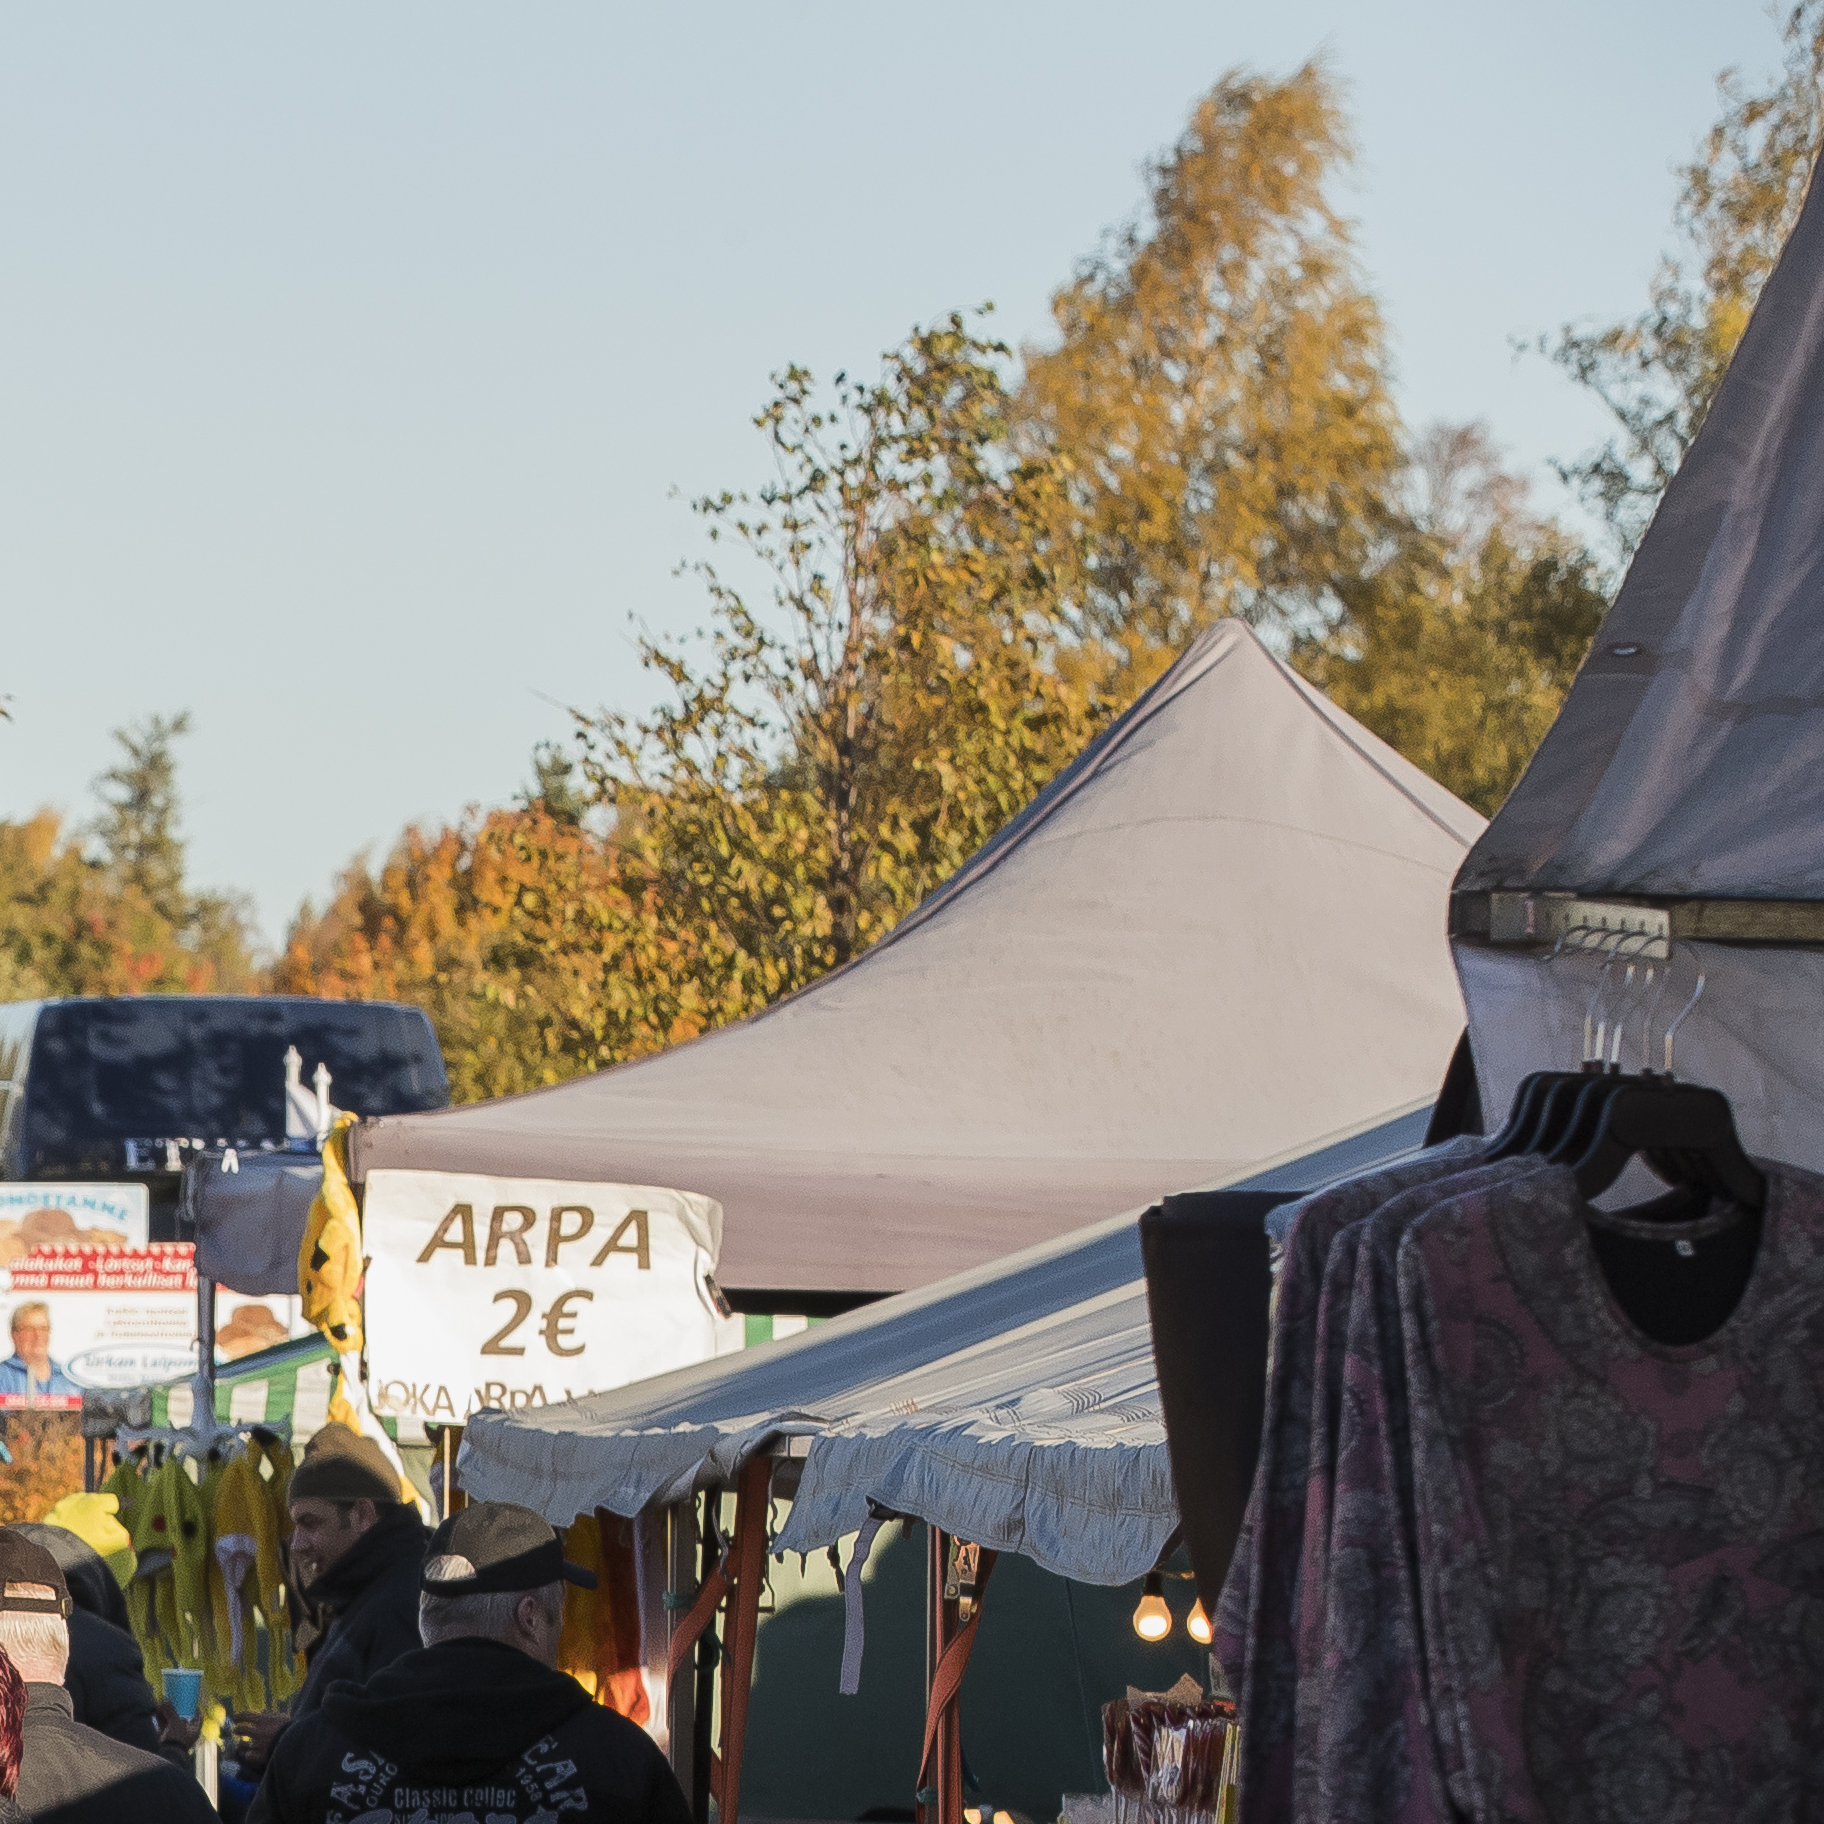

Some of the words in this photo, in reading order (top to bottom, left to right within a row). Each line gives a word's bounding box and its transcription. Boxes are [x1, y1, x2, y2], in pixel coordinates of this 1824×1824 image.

[416, 1203, 651, 1270] ARPA
[480, 1288, 594, 1357] 2€
[520, 1734, 589, 1813] CAR
